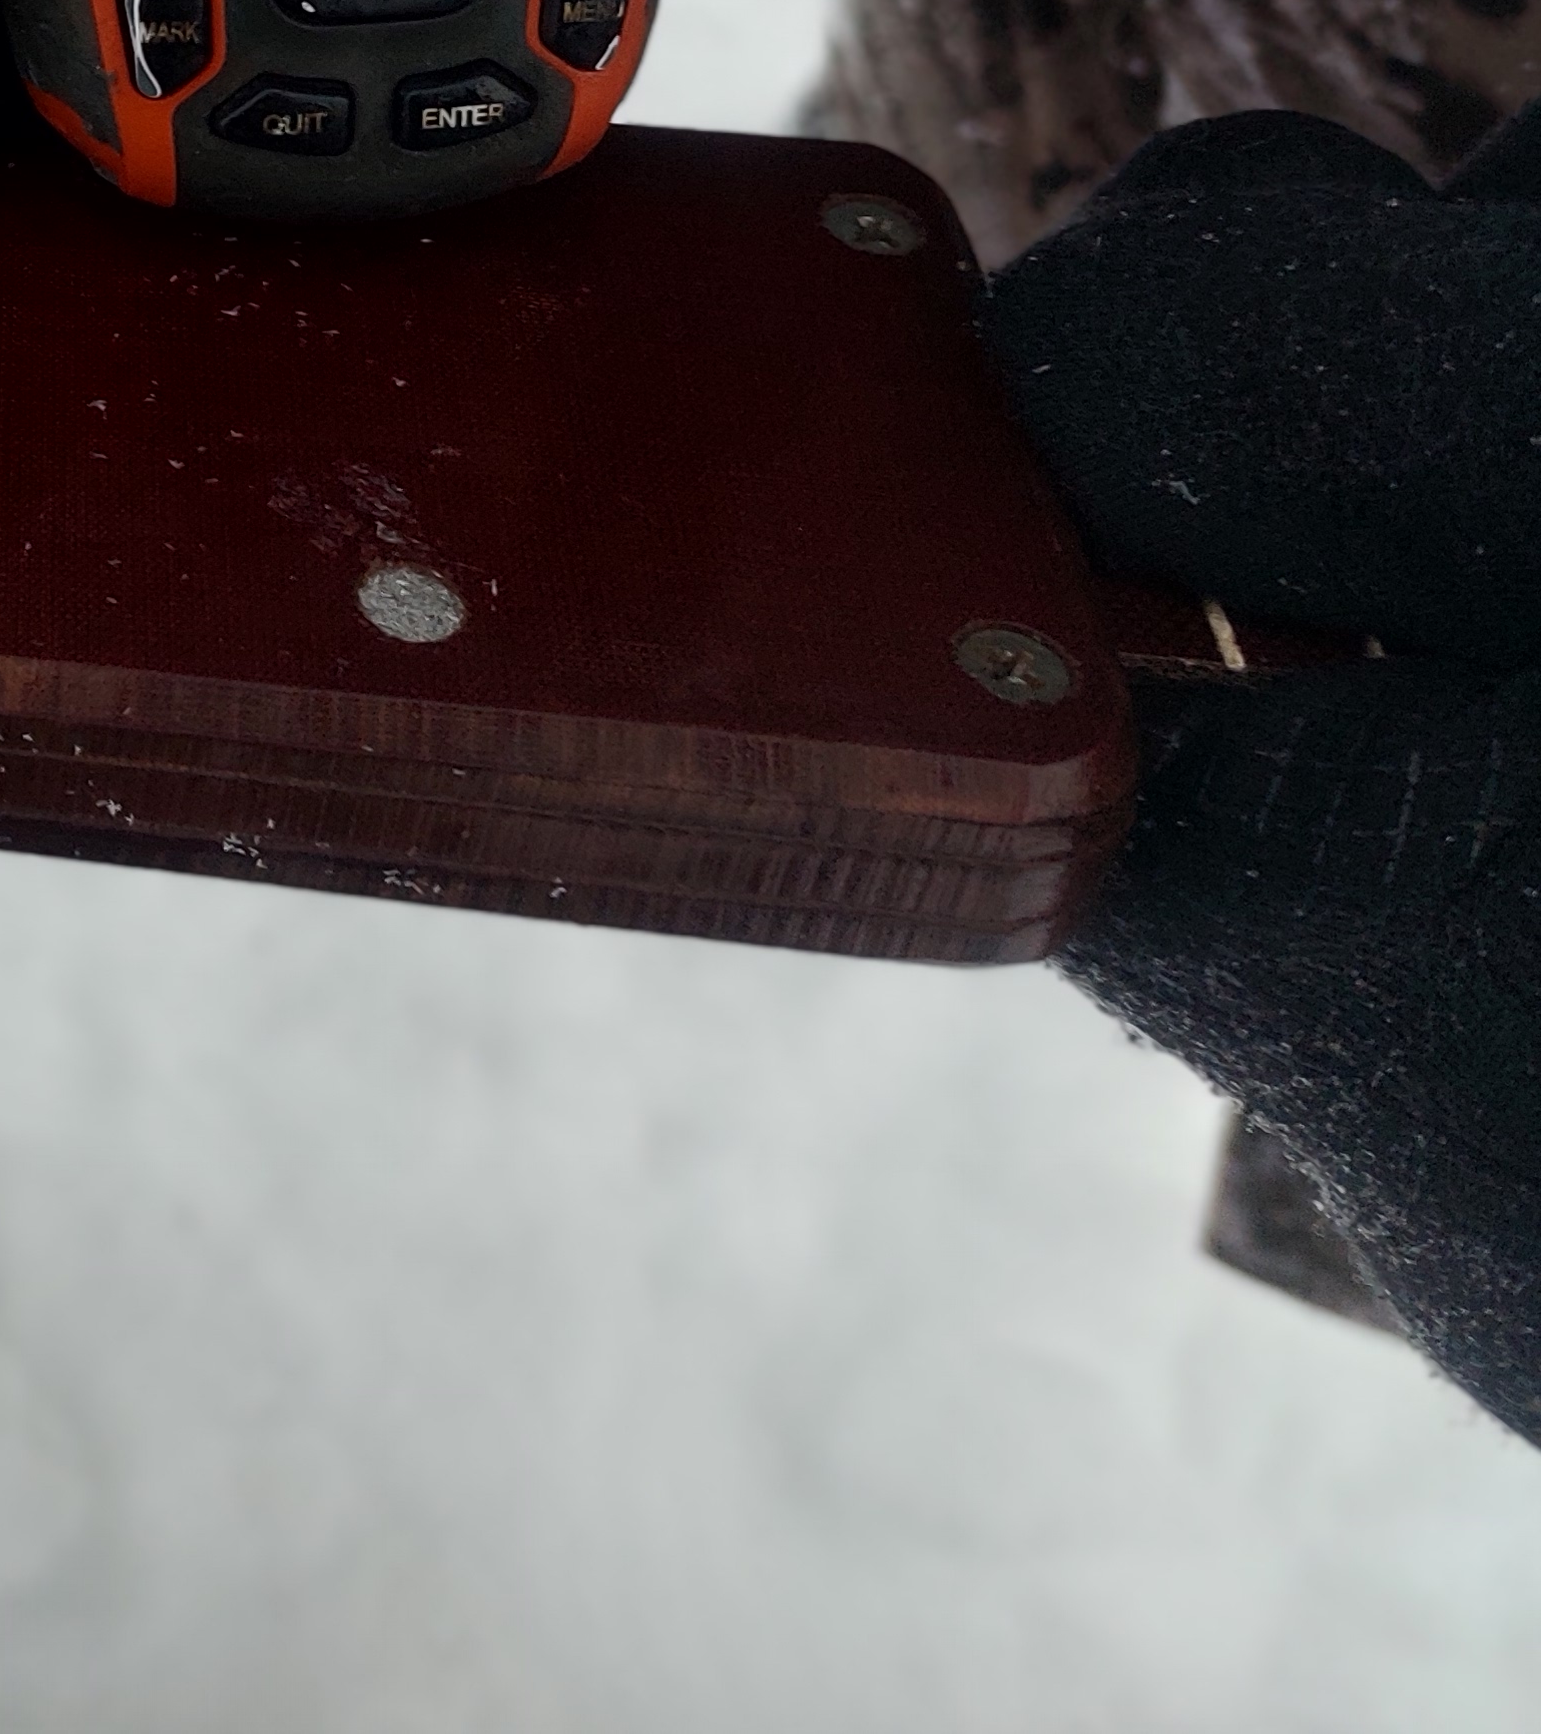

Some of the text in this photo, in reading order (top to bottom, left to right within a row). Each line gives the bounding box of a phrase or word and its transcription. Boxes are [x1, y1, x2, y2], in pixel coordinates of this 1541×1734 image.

[139, 20, 201, 44] MARK
[262, 111, 329, 137] QUIT
[421, 102, 505, 131] ENTER
